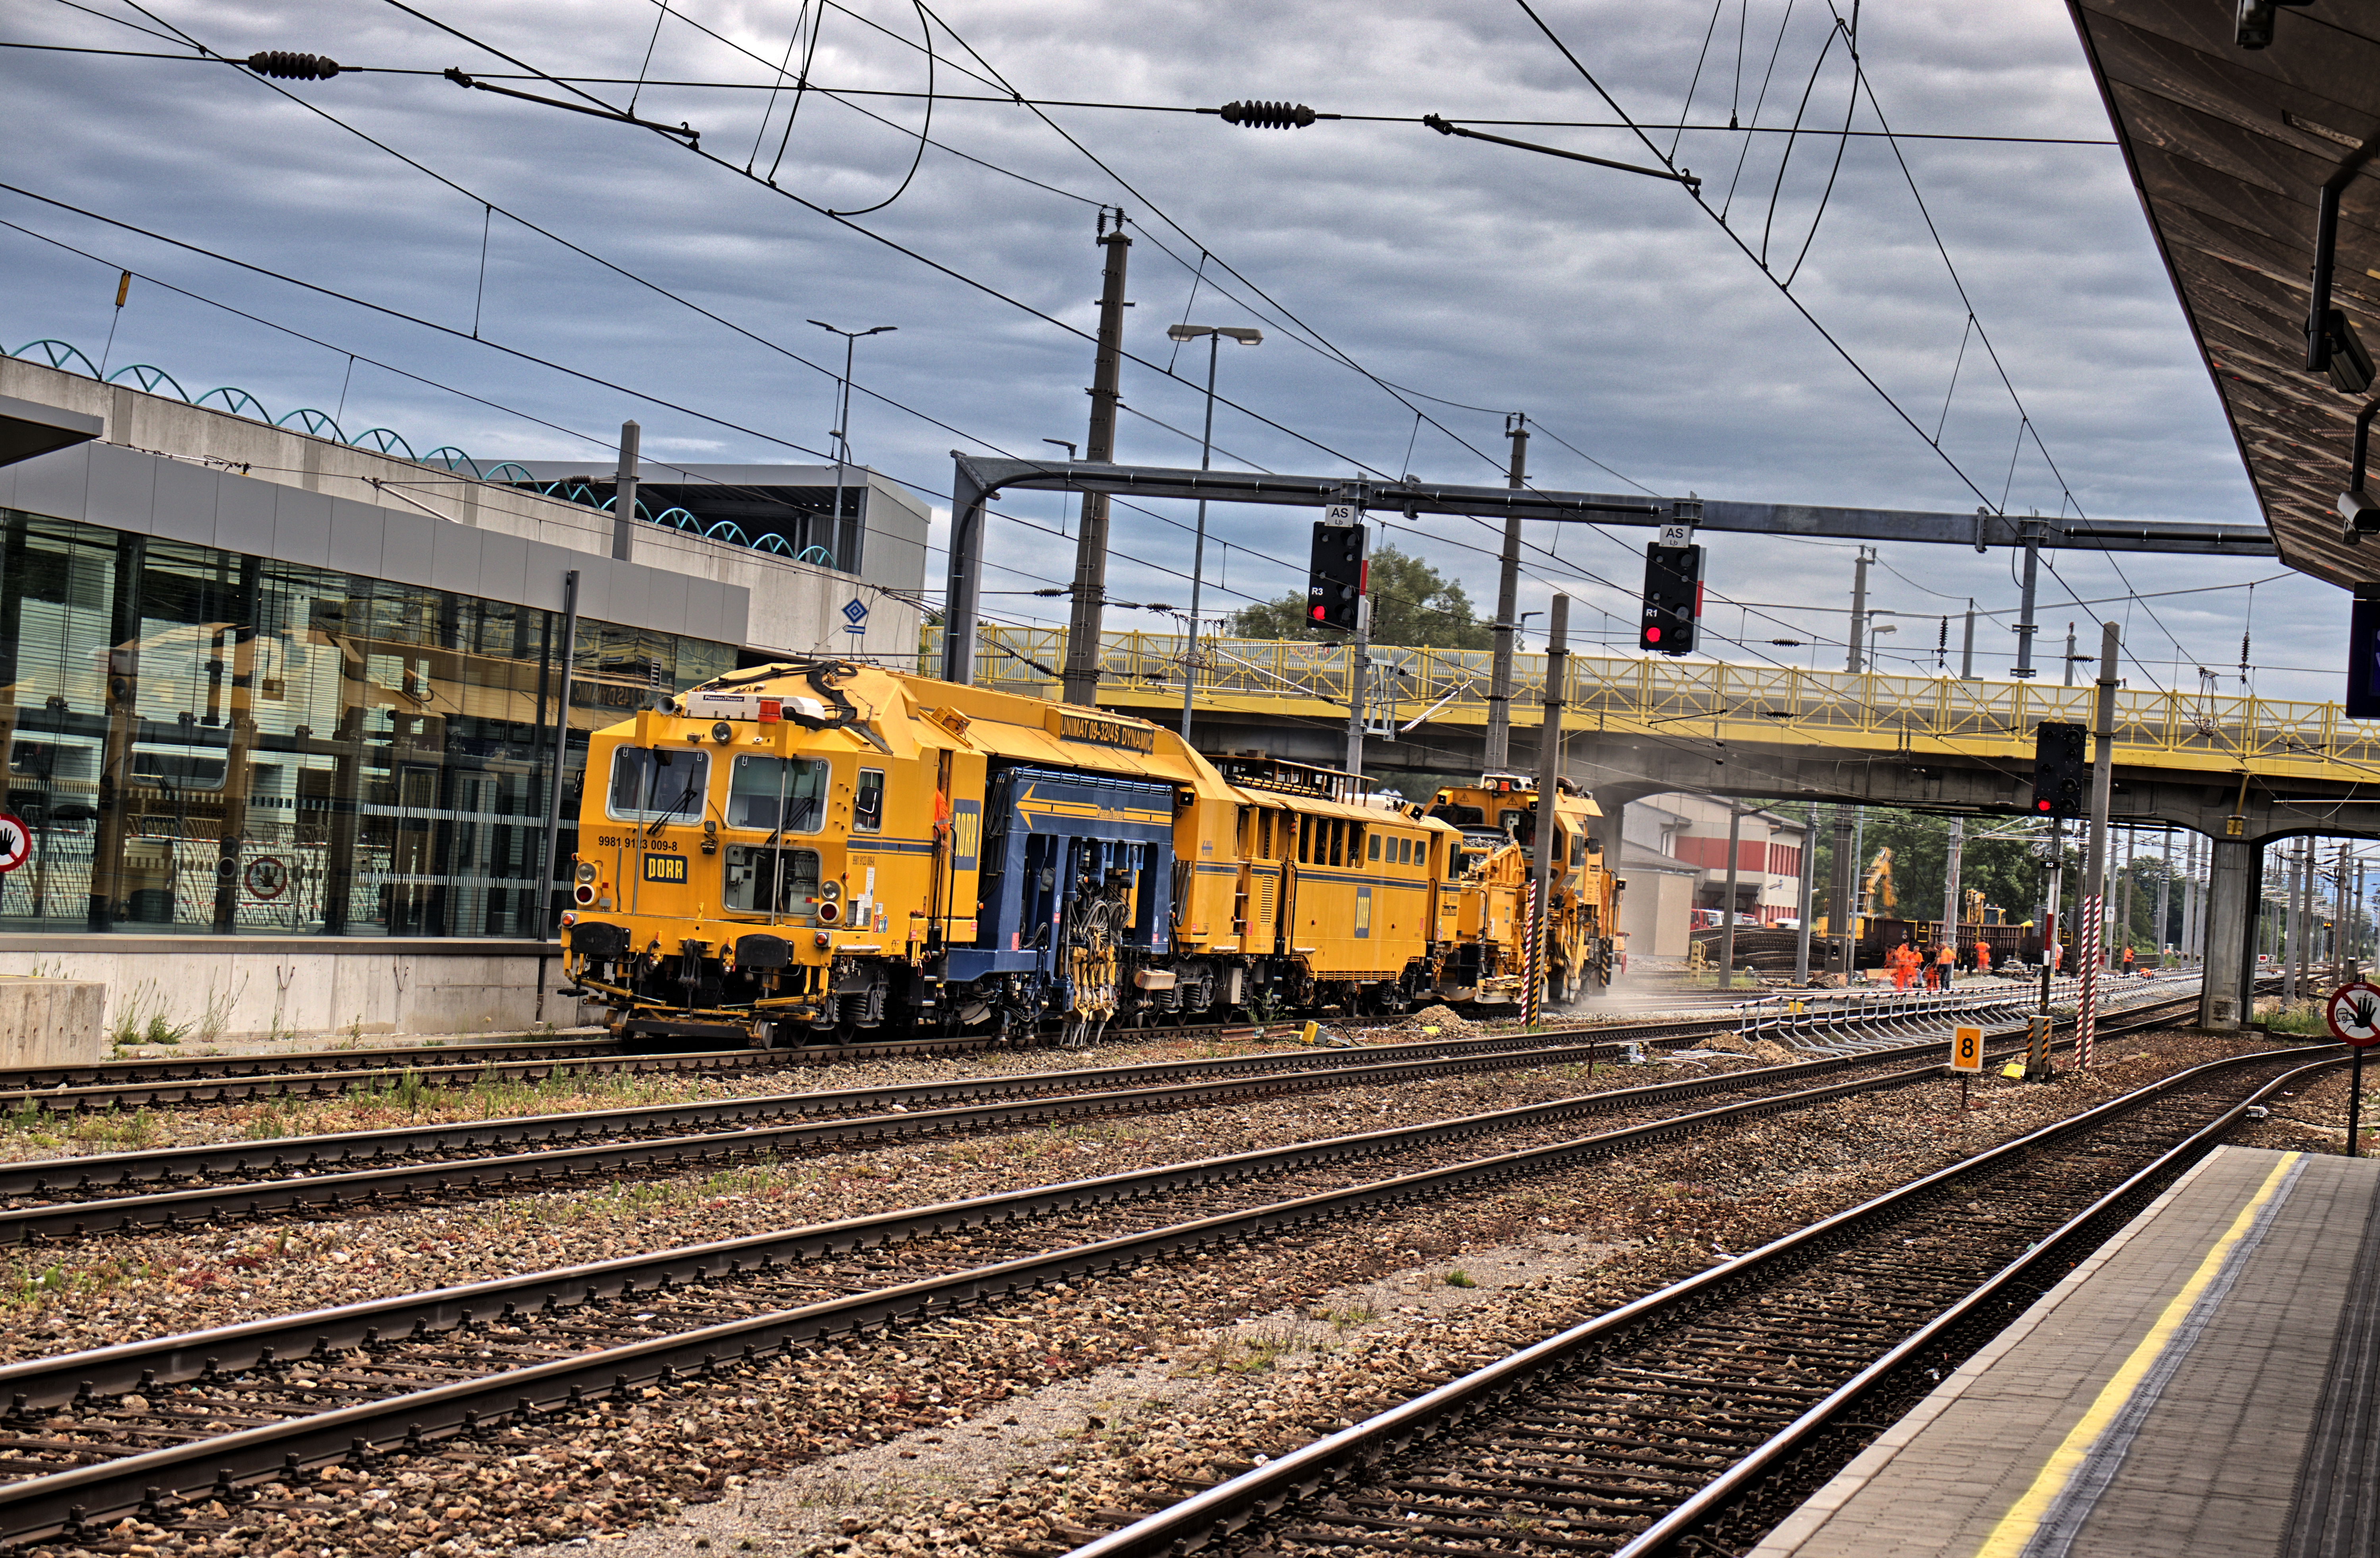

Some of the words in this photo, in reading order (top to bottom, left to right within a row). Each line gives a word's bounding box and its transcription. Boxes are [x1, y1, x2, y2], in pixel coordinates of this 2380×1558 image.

[1331, 507, 1349, 518] AS
[1666, 528, 1684, 538] AS
[1311, 587, 1323, 596] R3
[1646, 609, 1657, 617] R1
[1060, 716, 1089, 738] UNIMAT
[1089, 721, 1120, 742] 09-32/4S
[1121, 727, 1152, 751] DYNAMIC
[599, 836, 621, 847] 9981
[625, 838, 648, 849] 913
[651, 840, 677, 851] 009-8
[648, 858, 683, 879] PORR
[1356, 897, 1370, 931] PORR
[1961, 1037, 1973, 1058] 8
